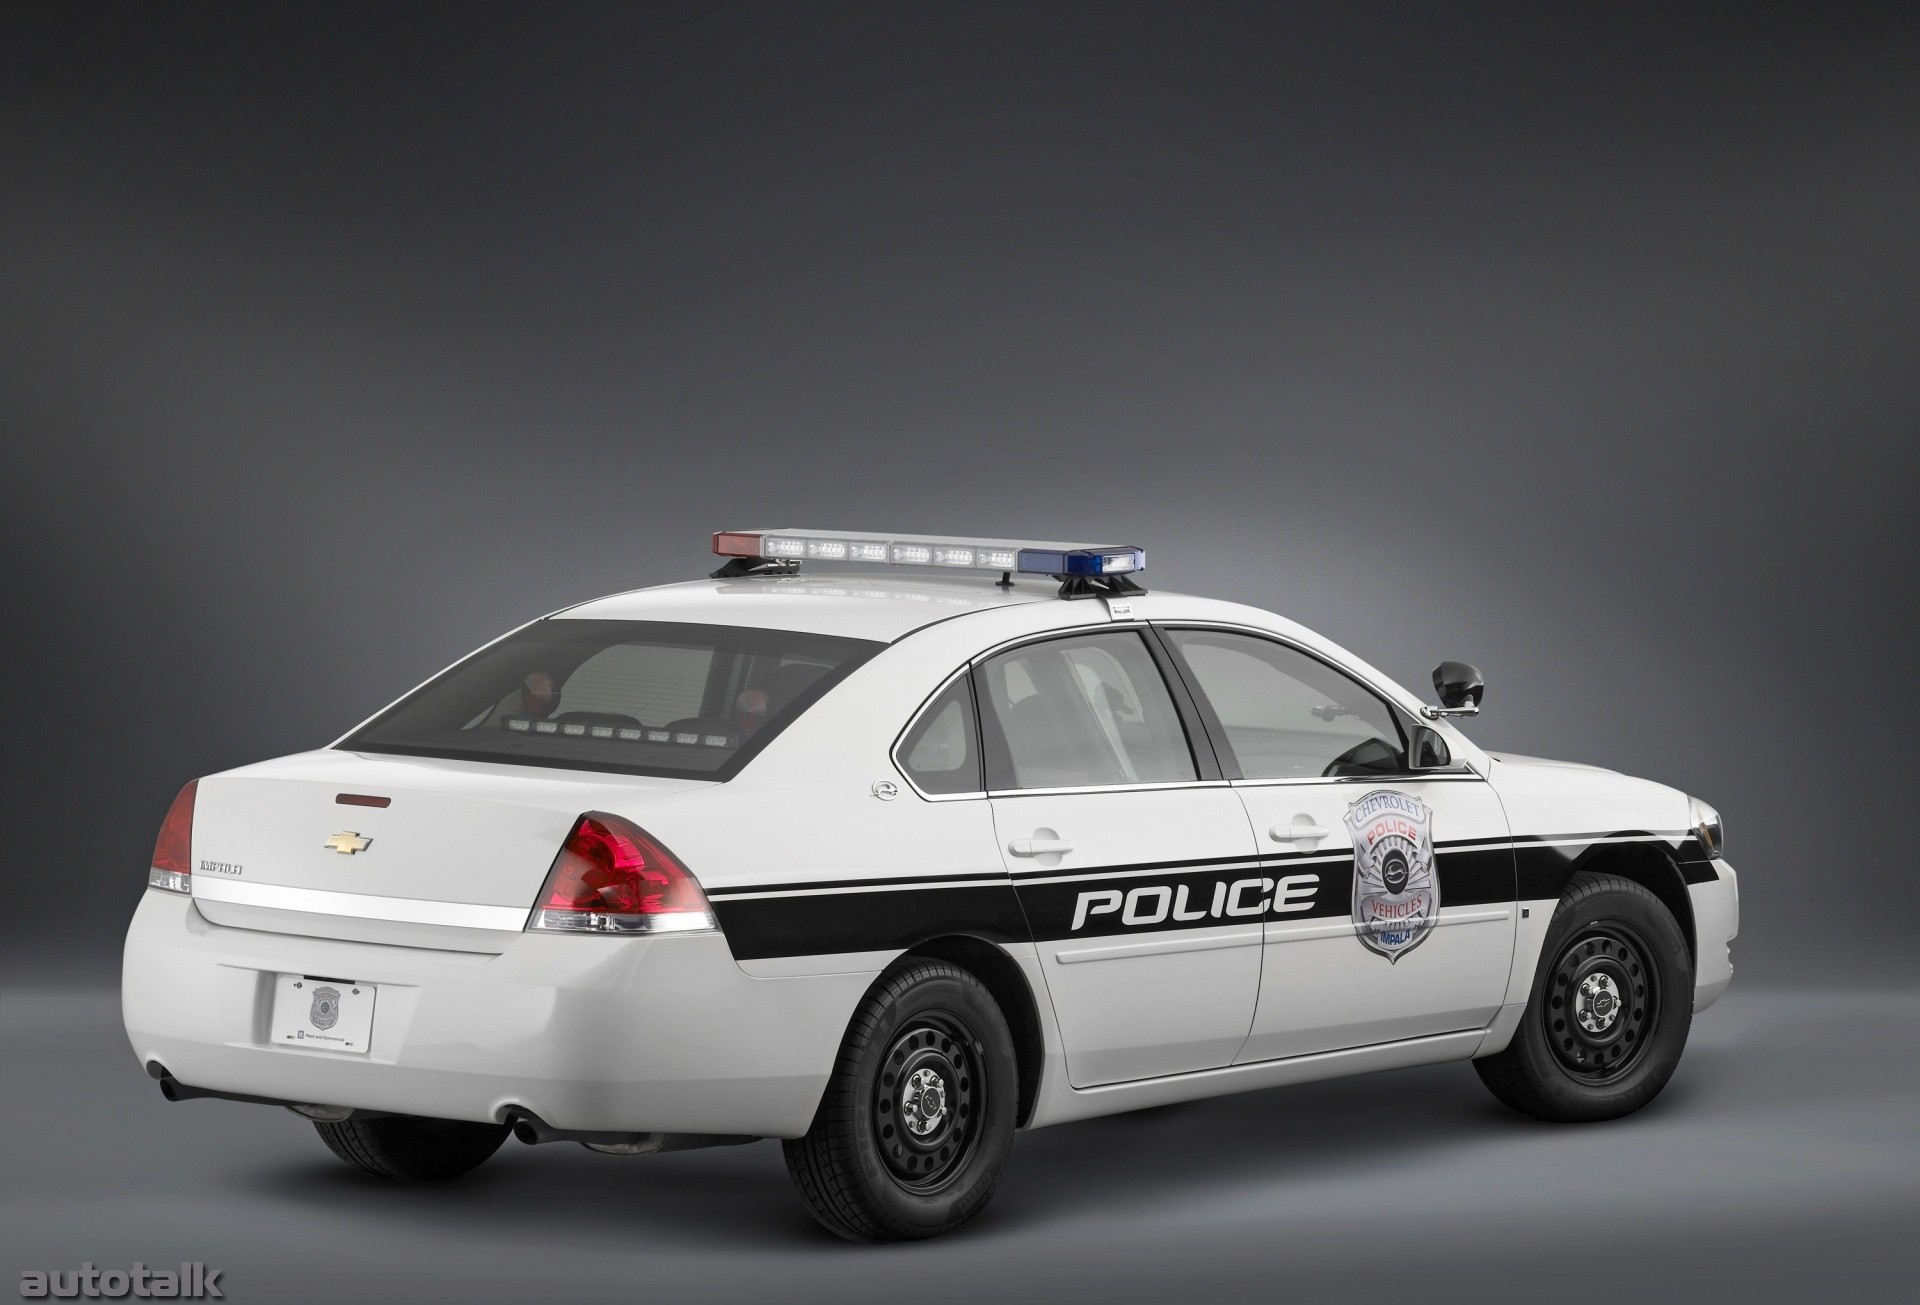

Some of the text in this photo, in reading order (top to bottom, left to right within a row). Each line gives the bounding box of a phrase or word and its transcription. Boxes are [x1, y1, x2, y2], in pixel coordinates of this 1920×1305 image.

[1355, 795, 1421, 823] CHEVROLET
[1366, 819, 1417, 846] POLICE
[1071, 874, 1320, 931] POLICE
[1371, 894, 1422, 918] VEHICLES
[1379, 928, 1412, 945] IMPALA
